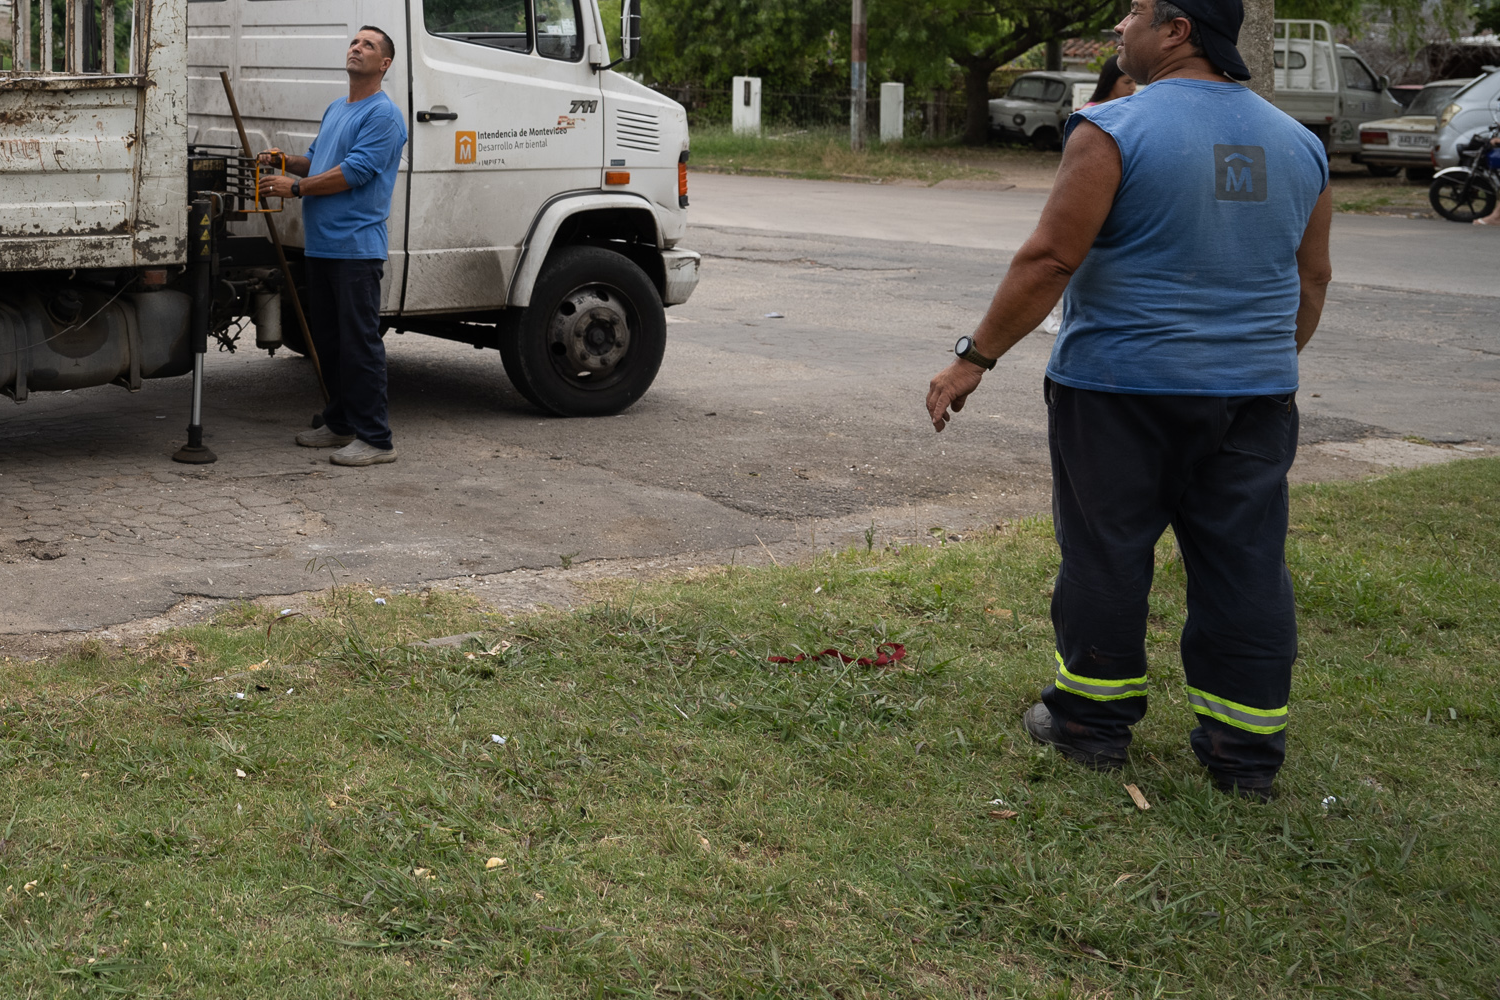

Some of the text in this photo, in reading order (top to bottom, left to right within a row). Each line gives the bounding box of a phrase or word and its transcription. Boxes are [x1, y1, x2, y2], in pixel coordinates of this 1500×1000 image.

[569, 99, 598, 114] 711
[477, 126, 567, 140] Intendencia de Montevideo
[478, 138, 548, 152] Desarrollo Ambiental
